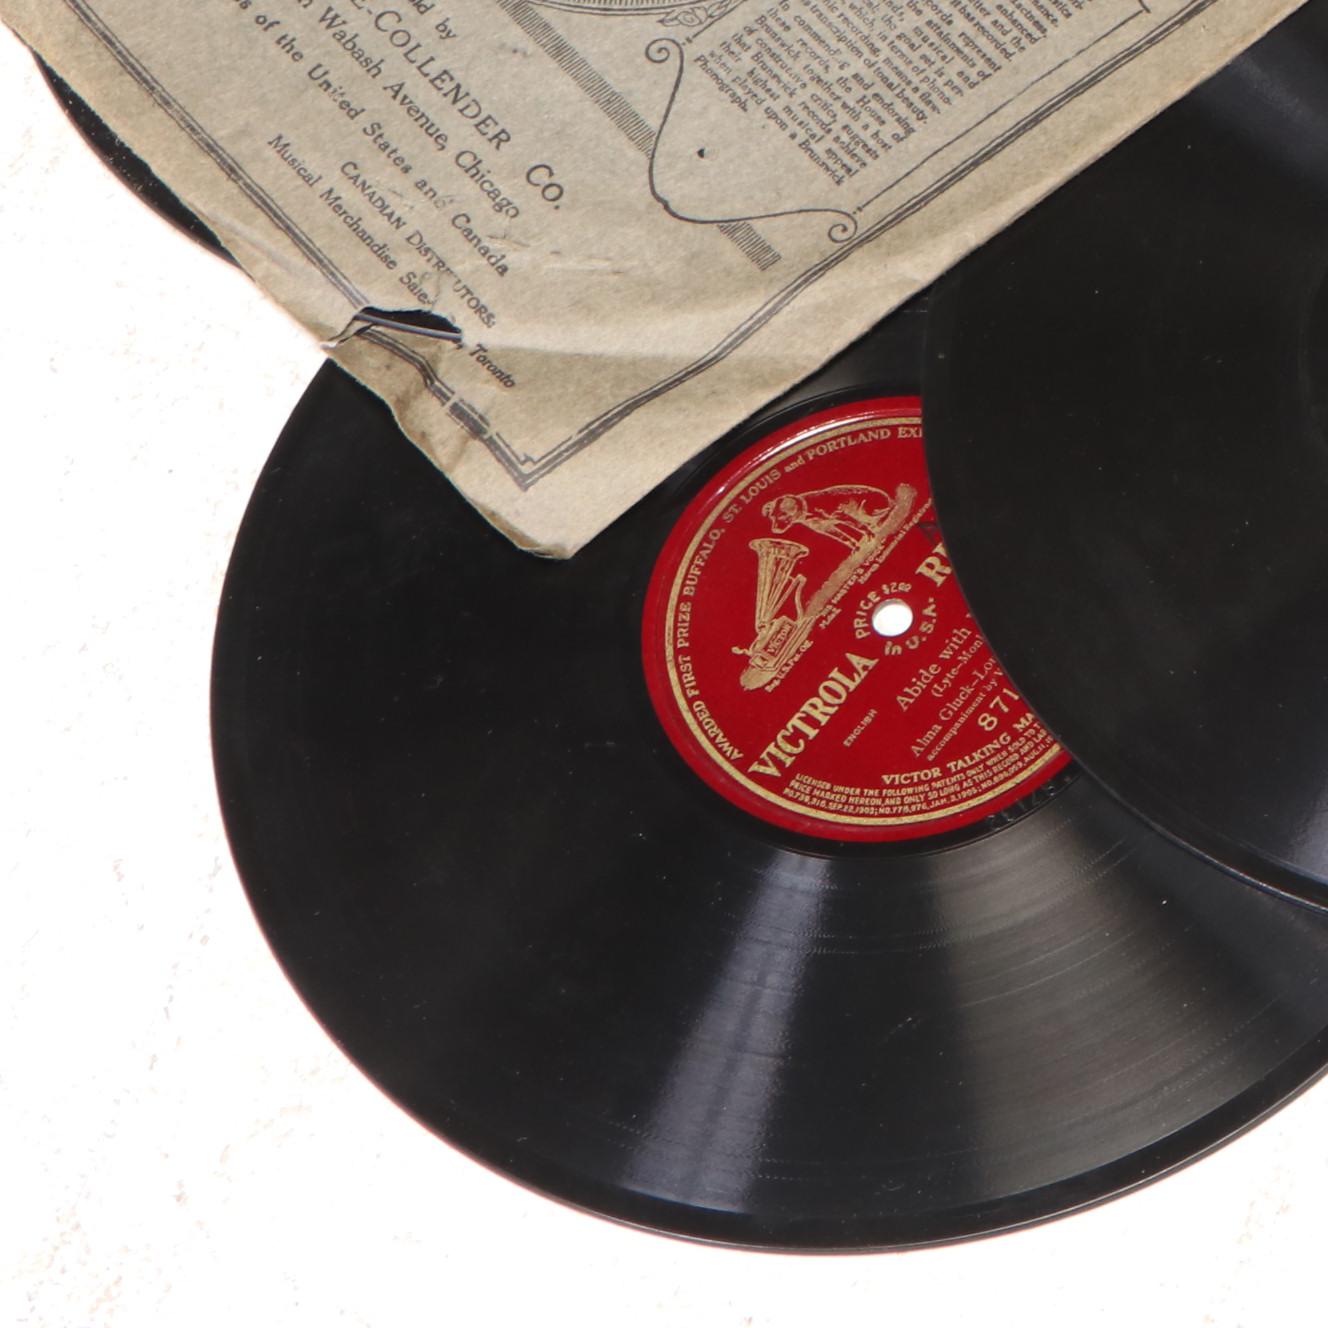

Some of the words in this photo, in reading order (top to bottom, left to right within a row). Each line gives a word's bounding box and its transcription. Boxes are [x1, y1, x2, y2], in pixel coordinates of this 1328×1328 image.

[434, 16, 459, 43] by
[318, 6, 385, 79] Wabash
[383, 79, 449, 151] Avenue,
[454, 148, 520, 220] Chicago
[255, 15, 280, 32] of
[275, 33, 304, 62] the
[363, 121, 412, 174] States
[452, 212, 509, 277] Canada
[267, 133, 323, 188] Musical
[319, 187, 398, 271] Merchandise
[340, 161, 407, 231] CANADIAN
[524, 163, 568, 210] CO.
[469, 343, 516, 389] Toronto
[784, 454, 807, 473] and
[805, 429, 892, 461] PORTLAND
[742, 468, 782, 504] LOUIS
[722, 501, 743, 524] ST.
[683, 528, 726, 597] BUFFALO,
[677, 601, 692, 649] PRIZE
[767, 623, 793, 654] VICTOR
[854, 591, 881, 639] PRICE
[884, 641, 902, 656] in
[905, 597, 937, 649] U.S.A.
[678, 654, 700, 699] FIRST
[896, 664, 942, 712] Abide
[939, 627, 972, 660] with
[692, 700, 745, 761] AWARDED
[748, 652, 879, 778] VICTROLA
[842, 708, 878, 748] ENGLISH
[927, 692, 987, 762] accompaniment
[984, 678, 998, 692] by
[882, 767, 942, 786] VICTOR
[946, 731, 1011, 773] TALKING
[911, 723, 943, 758] Alma
[833, 785, 861, 795] UNDER
